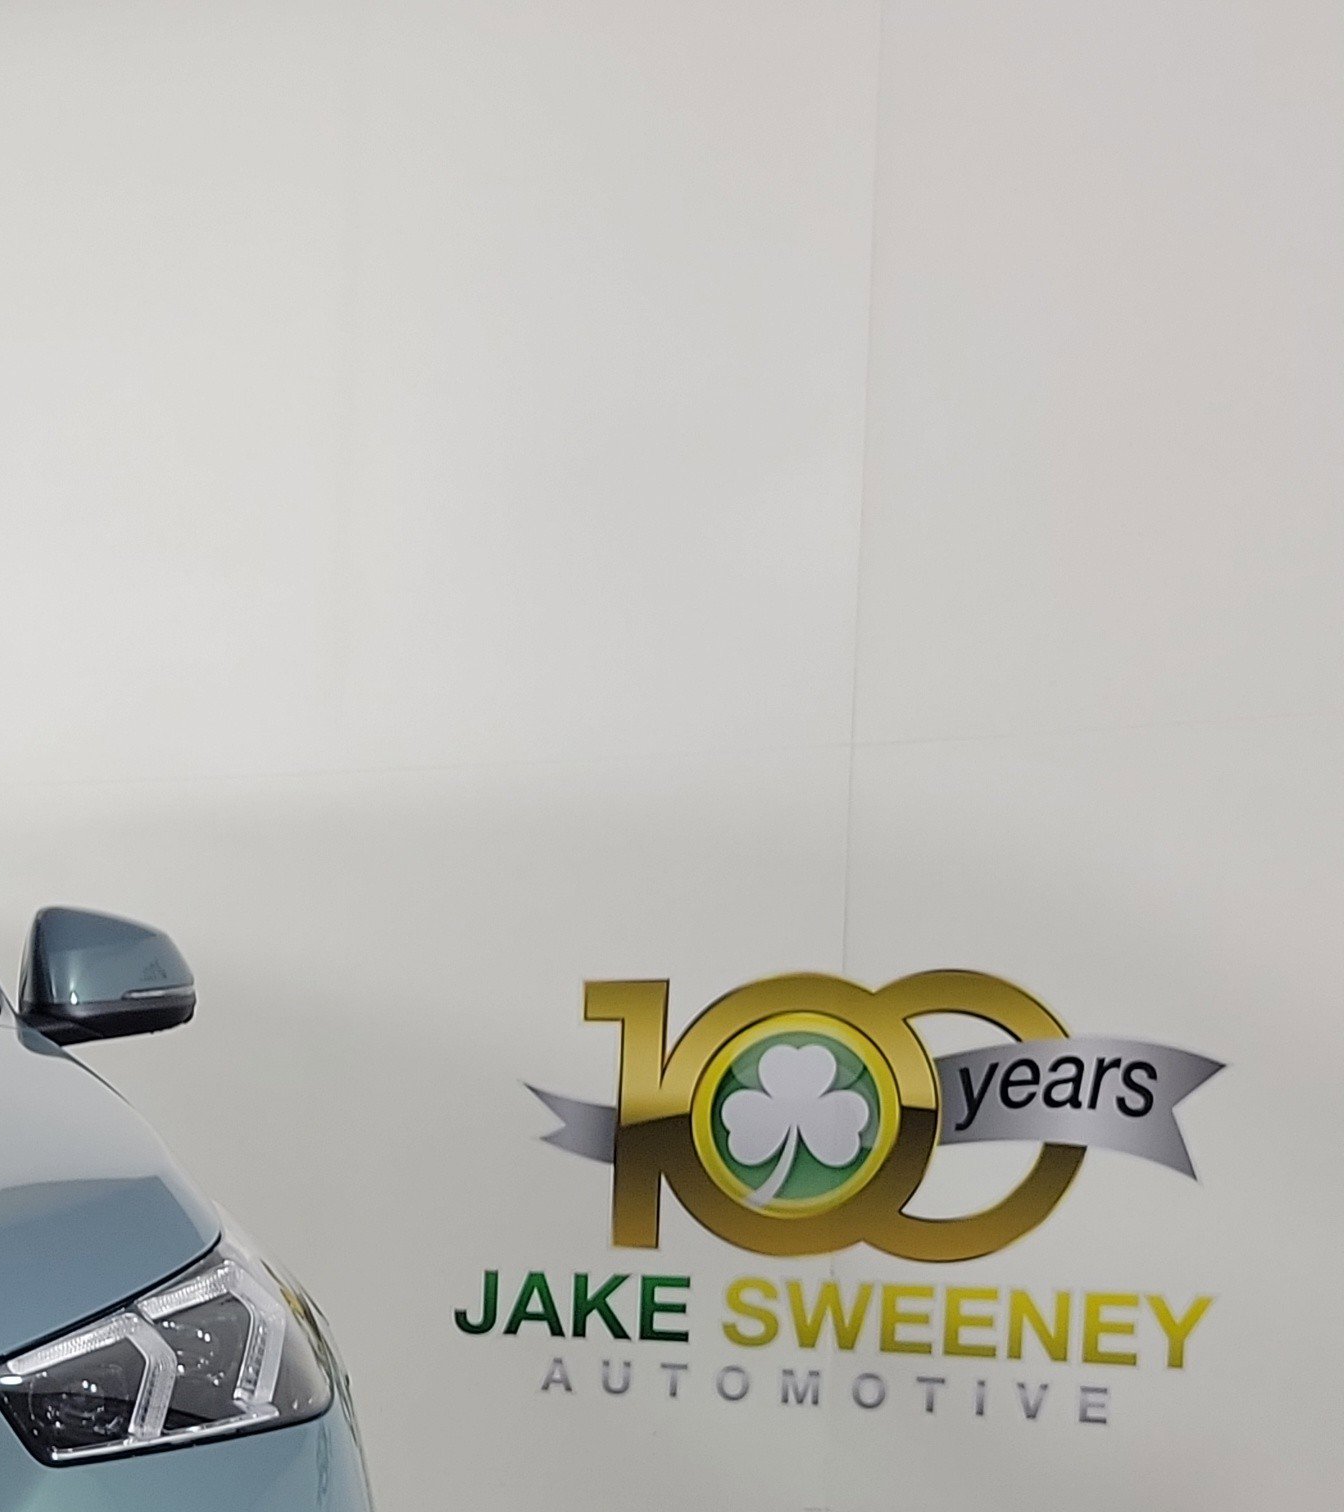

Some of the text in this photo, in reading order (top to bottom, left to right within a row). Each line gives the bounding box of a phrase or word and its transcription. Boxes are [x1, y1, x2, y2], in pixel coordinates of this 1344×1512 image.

[955, 1056, 1159, 1132] years
[454, 1270, 1214, 1370] JAKE SWEENEY
[540, 1357, 1109, 1424] AUTOMOTIVE
